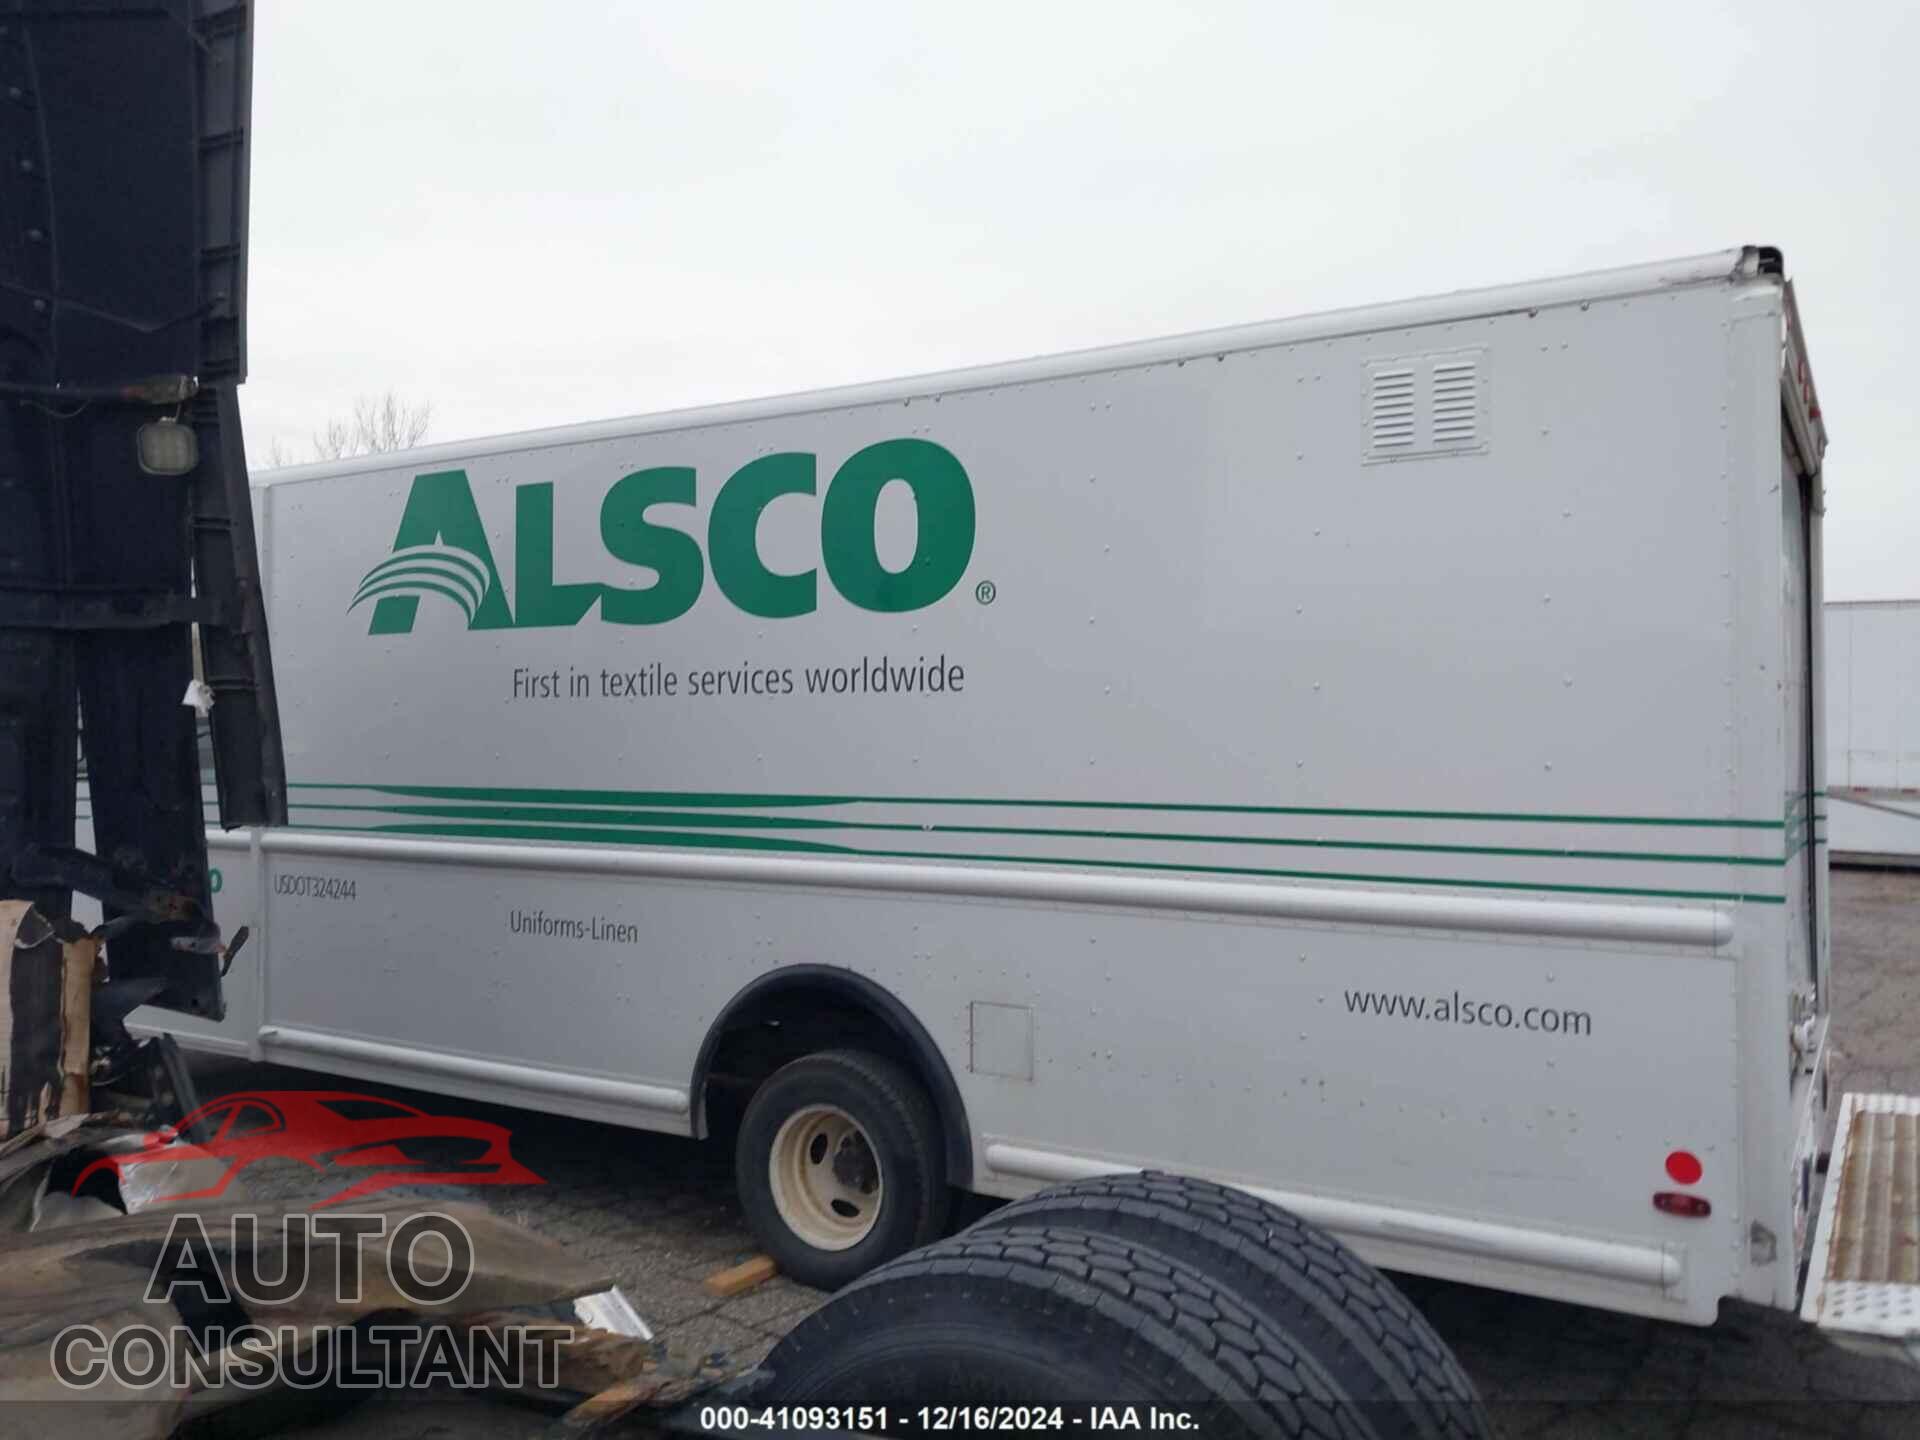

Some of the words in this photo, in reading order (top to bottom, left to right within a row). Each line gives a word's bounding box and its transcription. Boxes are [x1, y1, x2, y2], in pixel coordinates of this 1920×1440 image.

[347, 438, 976, 636] ALSCO
[512, 668, 560, 700] First
[568, 667, 591, 698] in
[600, 663, 679, 698] textile
[687, 661, 793, 696] services
[804, 655, 965, 694] worldwide
[275, 874, 357, 900] USDOT324244
[510, 911, 638, 943] Uniforms-Linen
[1344, 990, 1592, 1035] www.alsco.com
